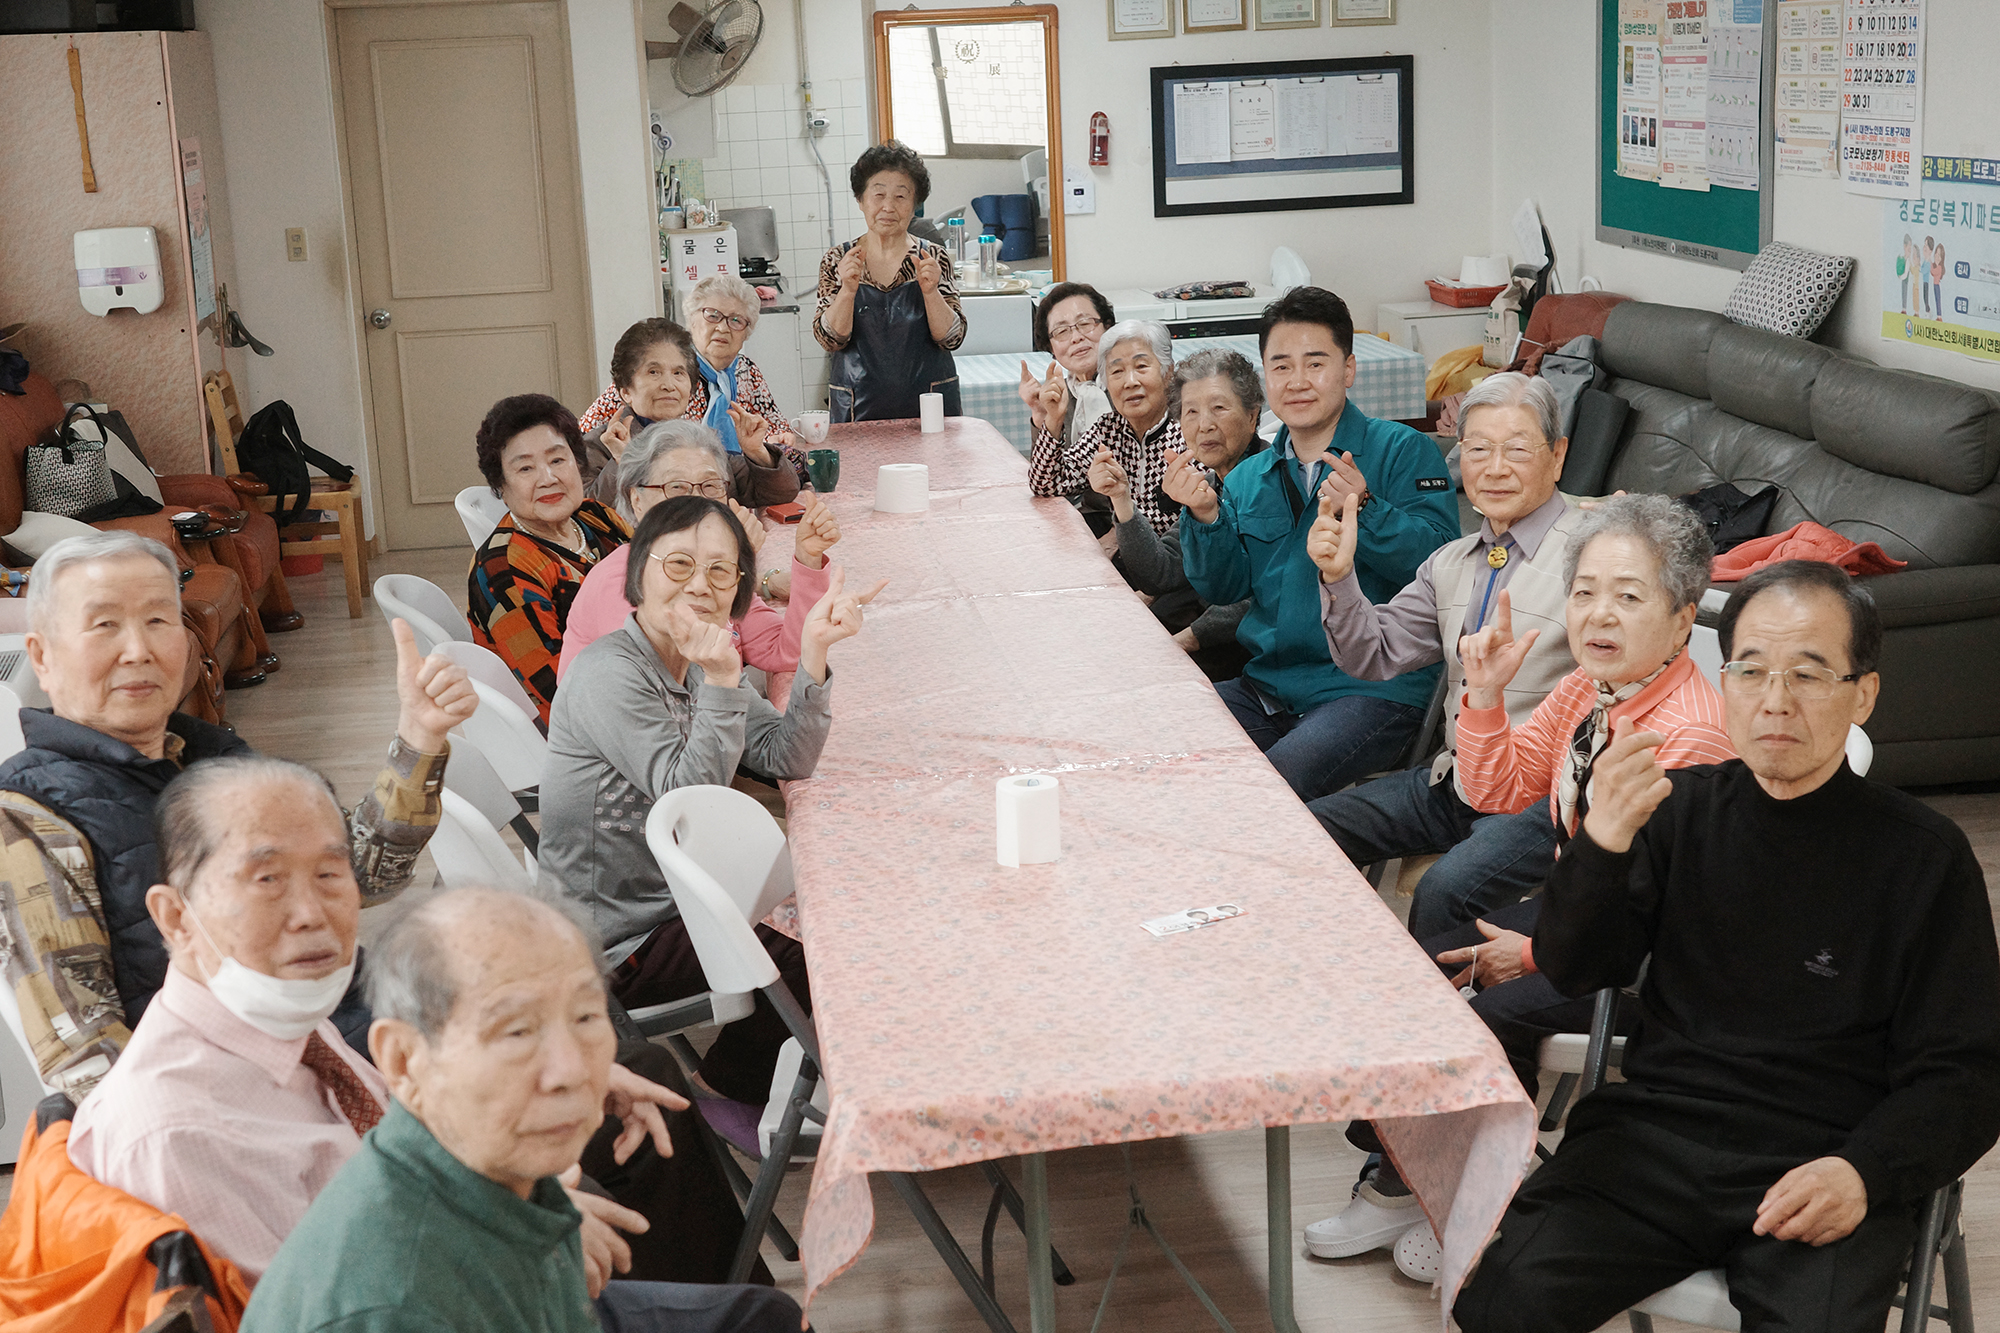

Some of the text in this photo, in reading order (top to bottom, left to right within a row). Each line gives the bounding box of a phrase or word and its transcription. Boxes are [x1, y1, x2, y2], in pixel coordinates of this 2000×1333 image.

[1848, 17, 1852, 31] 8
[1858, 16, 1863, 30] 9
[1867, 16, 1876, 30] 10
[1878, 16, 1885, 30] 11
[1888, 16, 1896, 30] 12
[1898, 16, 1907, 30] 13
[1909, 16, 1917, 30] 14
[1846, 42, 1916, 56] 15 16 17 18 19 20 21
[1844, 68, 1915, 84] 22 23 24 25 26 27 28
[1843, 94, 1851, 107] 29
[1852, 94, 1860, 108] 30
[1862, 95, 1870, 108] 31
[1859, 125, 1884, 136] 대한노인회
[1885, 126, 1911, 137] 도봉구지회
[1922, 157, 1953, 179] 강·행복
[1954, 159, 1972, 180] 가득
